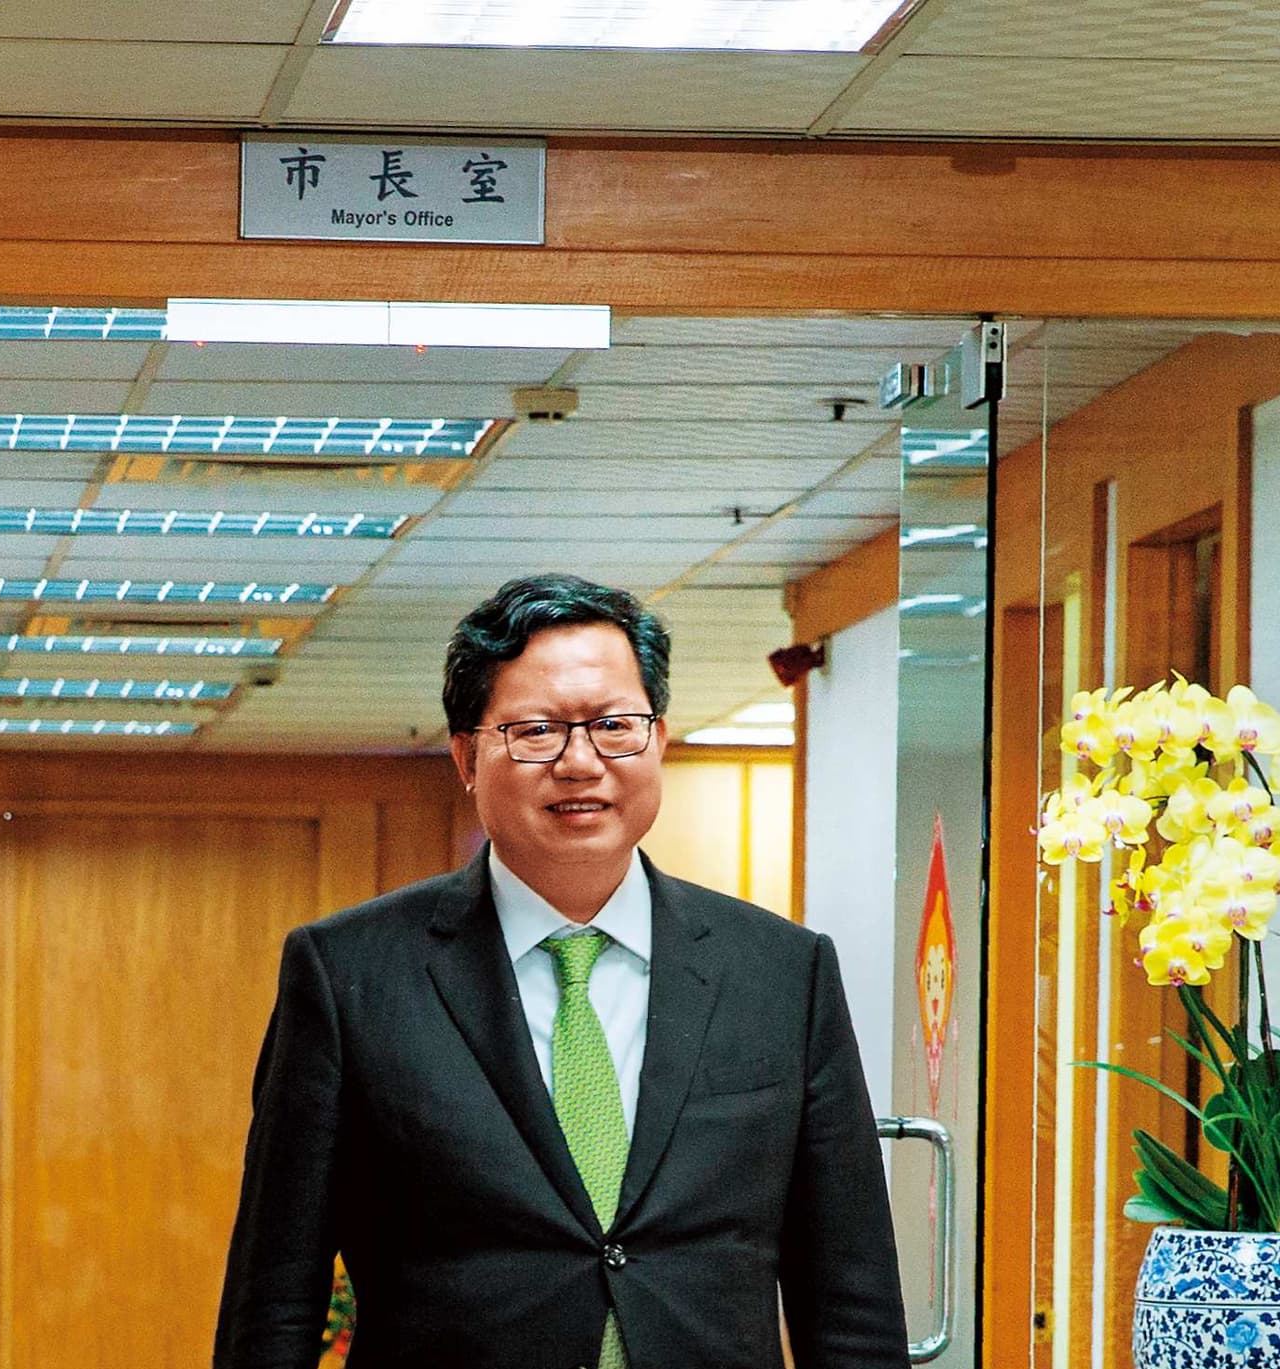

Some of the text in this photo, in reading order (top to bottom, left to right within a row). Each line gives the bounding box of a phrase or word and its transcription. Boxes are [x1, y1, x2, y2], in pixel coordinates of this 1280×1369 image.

[279, 147, 508, 203] 市長室
[331, 208, 454, 229] Mayor's Office
